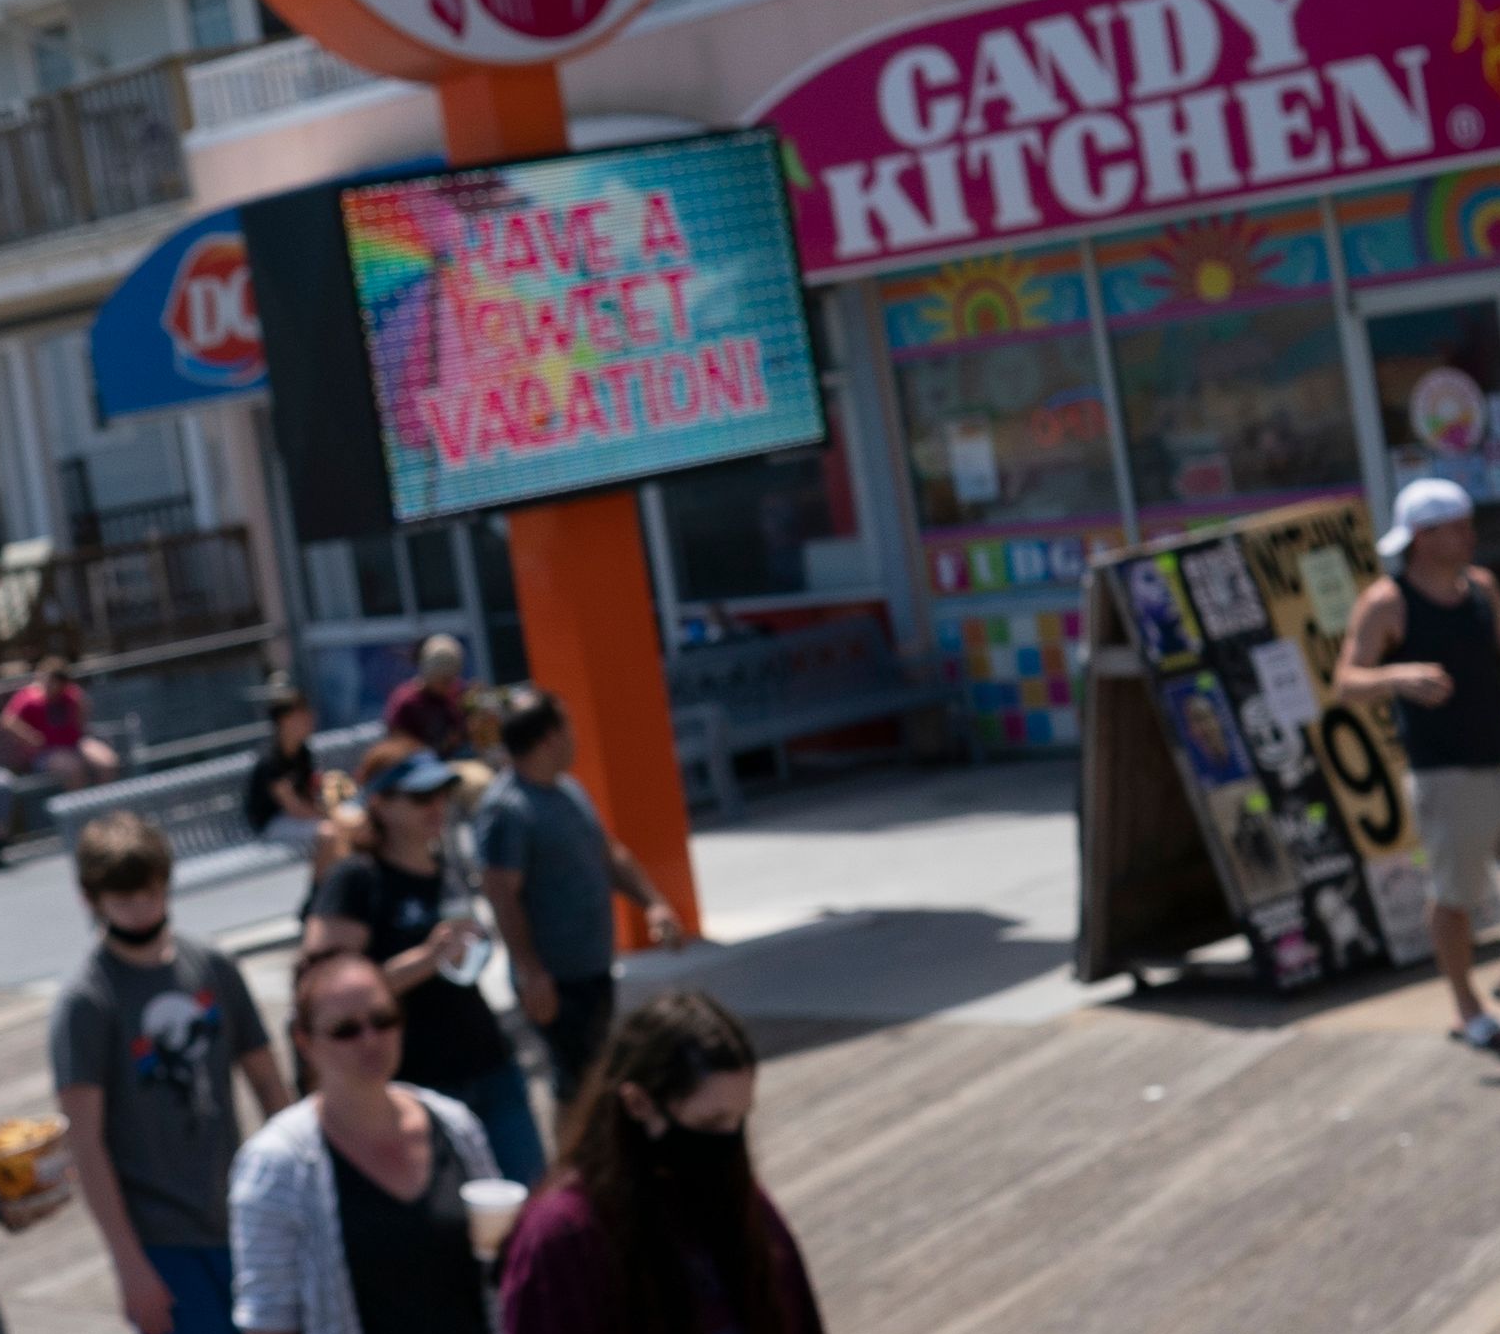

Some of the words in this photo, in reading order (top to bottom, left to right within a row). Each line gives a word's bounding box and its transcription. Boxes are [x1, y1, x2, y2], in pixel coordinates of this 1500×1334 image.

[821, 45, 1436, 261] KITCHEN
[454, 198, 611, 283] HAVE
[642, 190, 689, 259] A
[474, 267, 699, 365] SWEET
[424, 337, 770, 465] VACATION!
